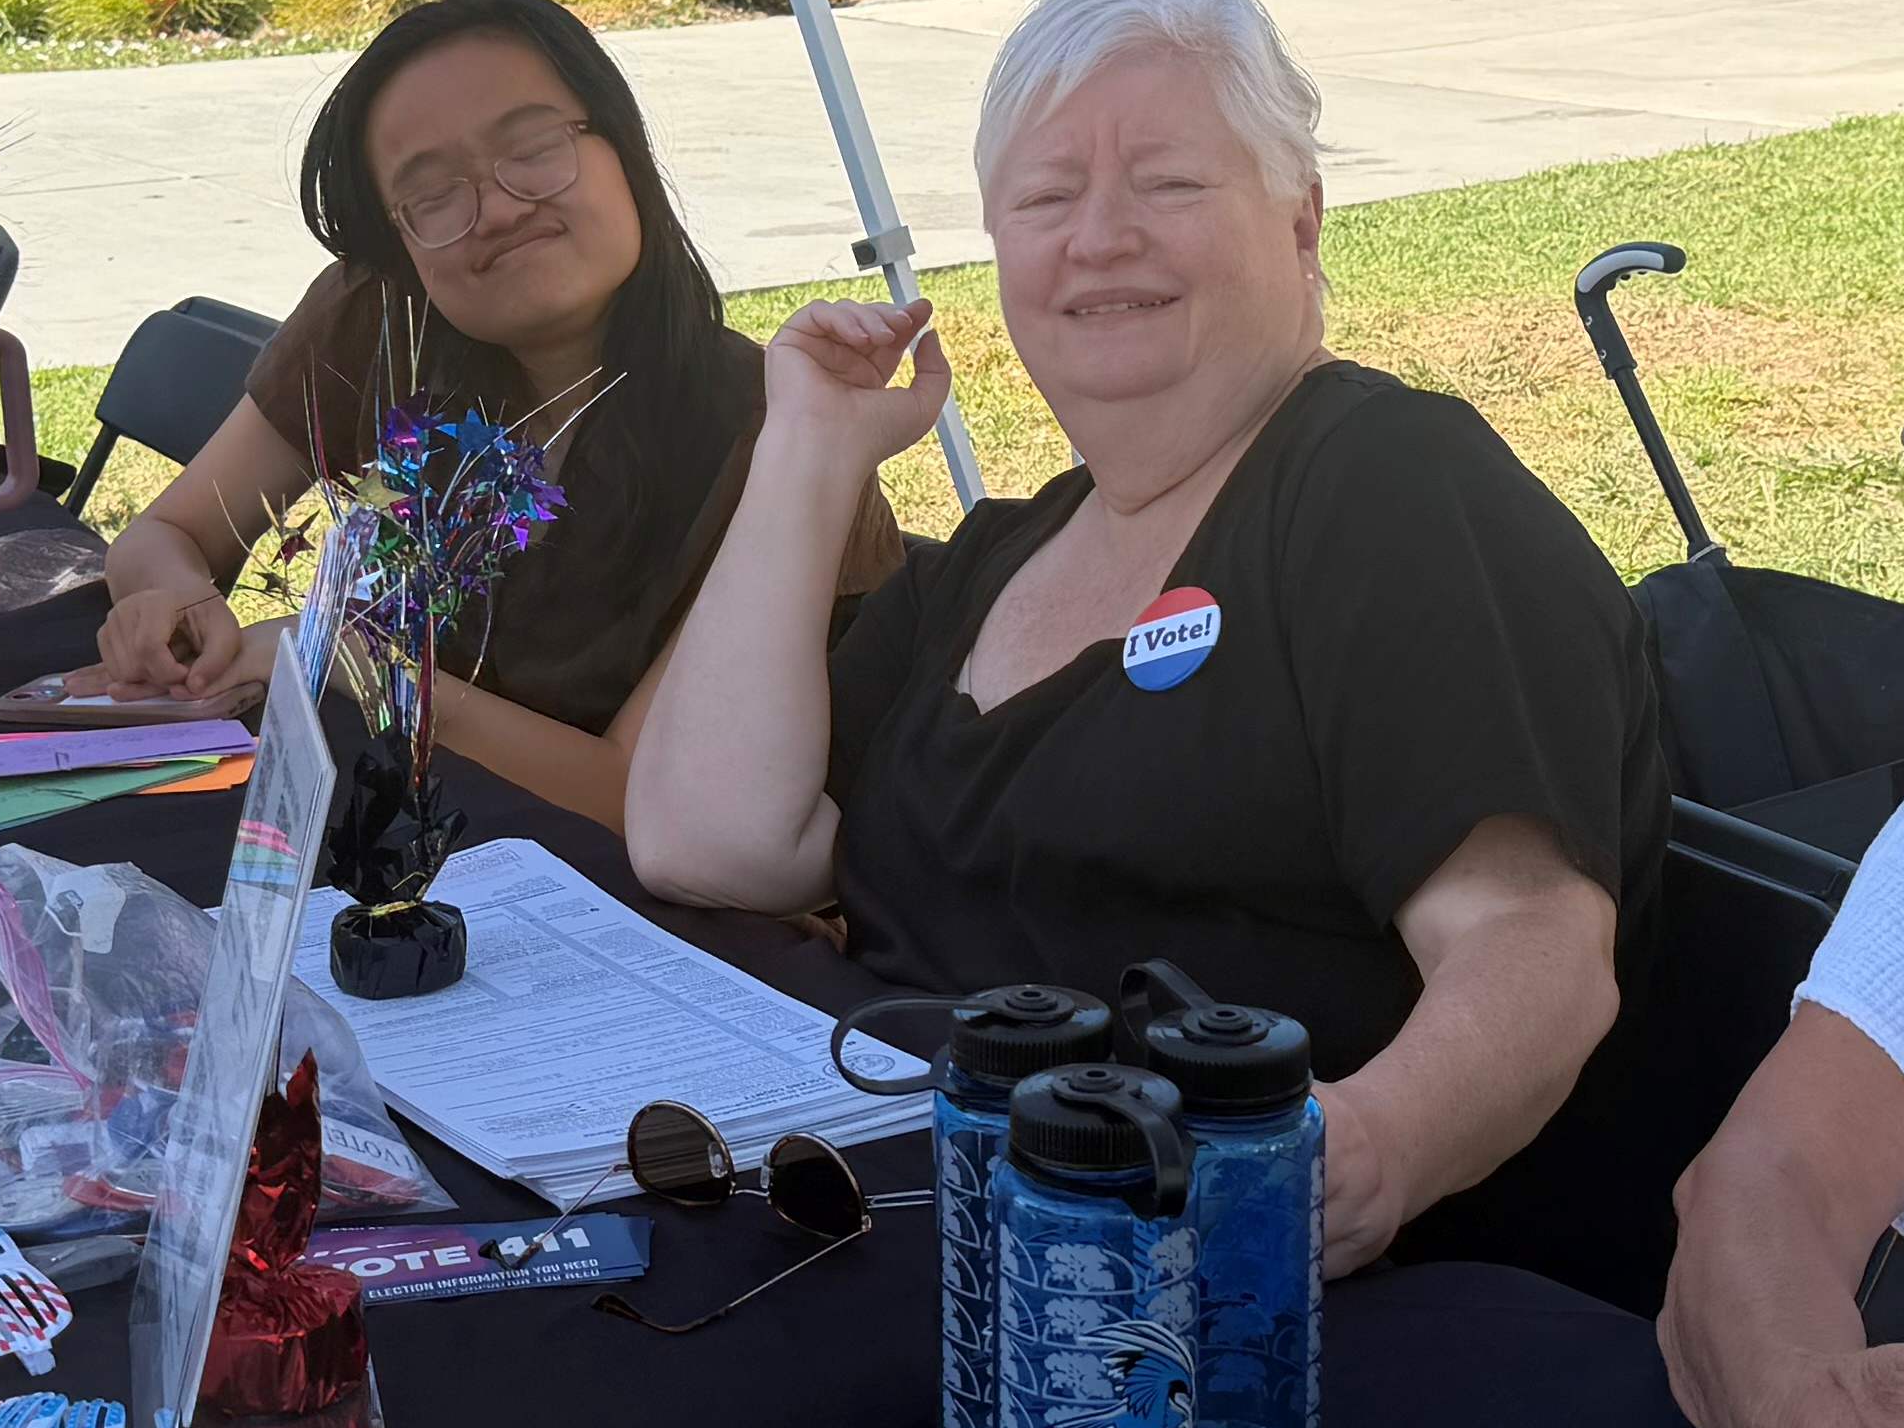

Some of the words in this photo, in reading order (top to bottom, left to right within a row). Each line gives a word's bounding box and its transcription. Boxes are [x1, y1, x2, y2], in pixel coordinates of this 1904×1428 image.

[1127, 635, 1138, 657] I
[1145, 613, 1212, 652] Vote!
[332, 1244, 471, 1278] OTE
[368, 1280, 434, 1300] ELECTION
[437, 1268, 530, 1290] INFORMATION
[534, 1261, 561, 1276] YOU
[564, 1257, 599, 1273] NEED
